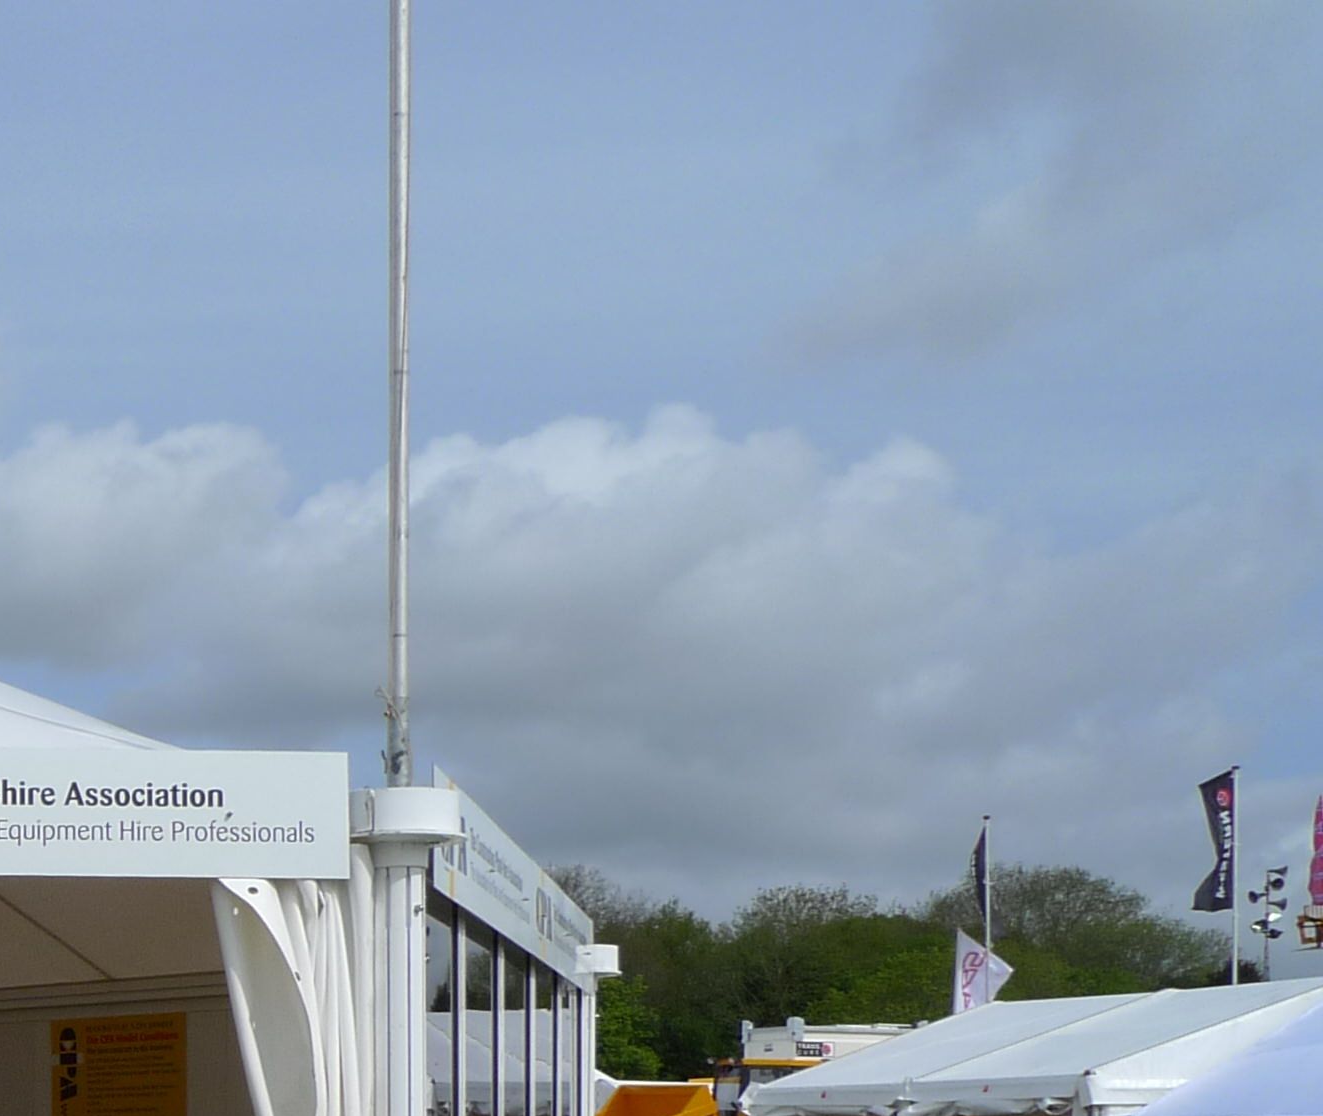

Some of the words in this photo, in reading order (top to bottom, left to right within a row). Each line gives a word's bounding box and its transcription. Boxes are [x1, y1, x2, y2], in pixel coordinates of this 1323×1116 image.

[64, 781, 224, 808] Association
[120, 820, 164, 843] Hire
[171, 820, 315, 844] Professionals
